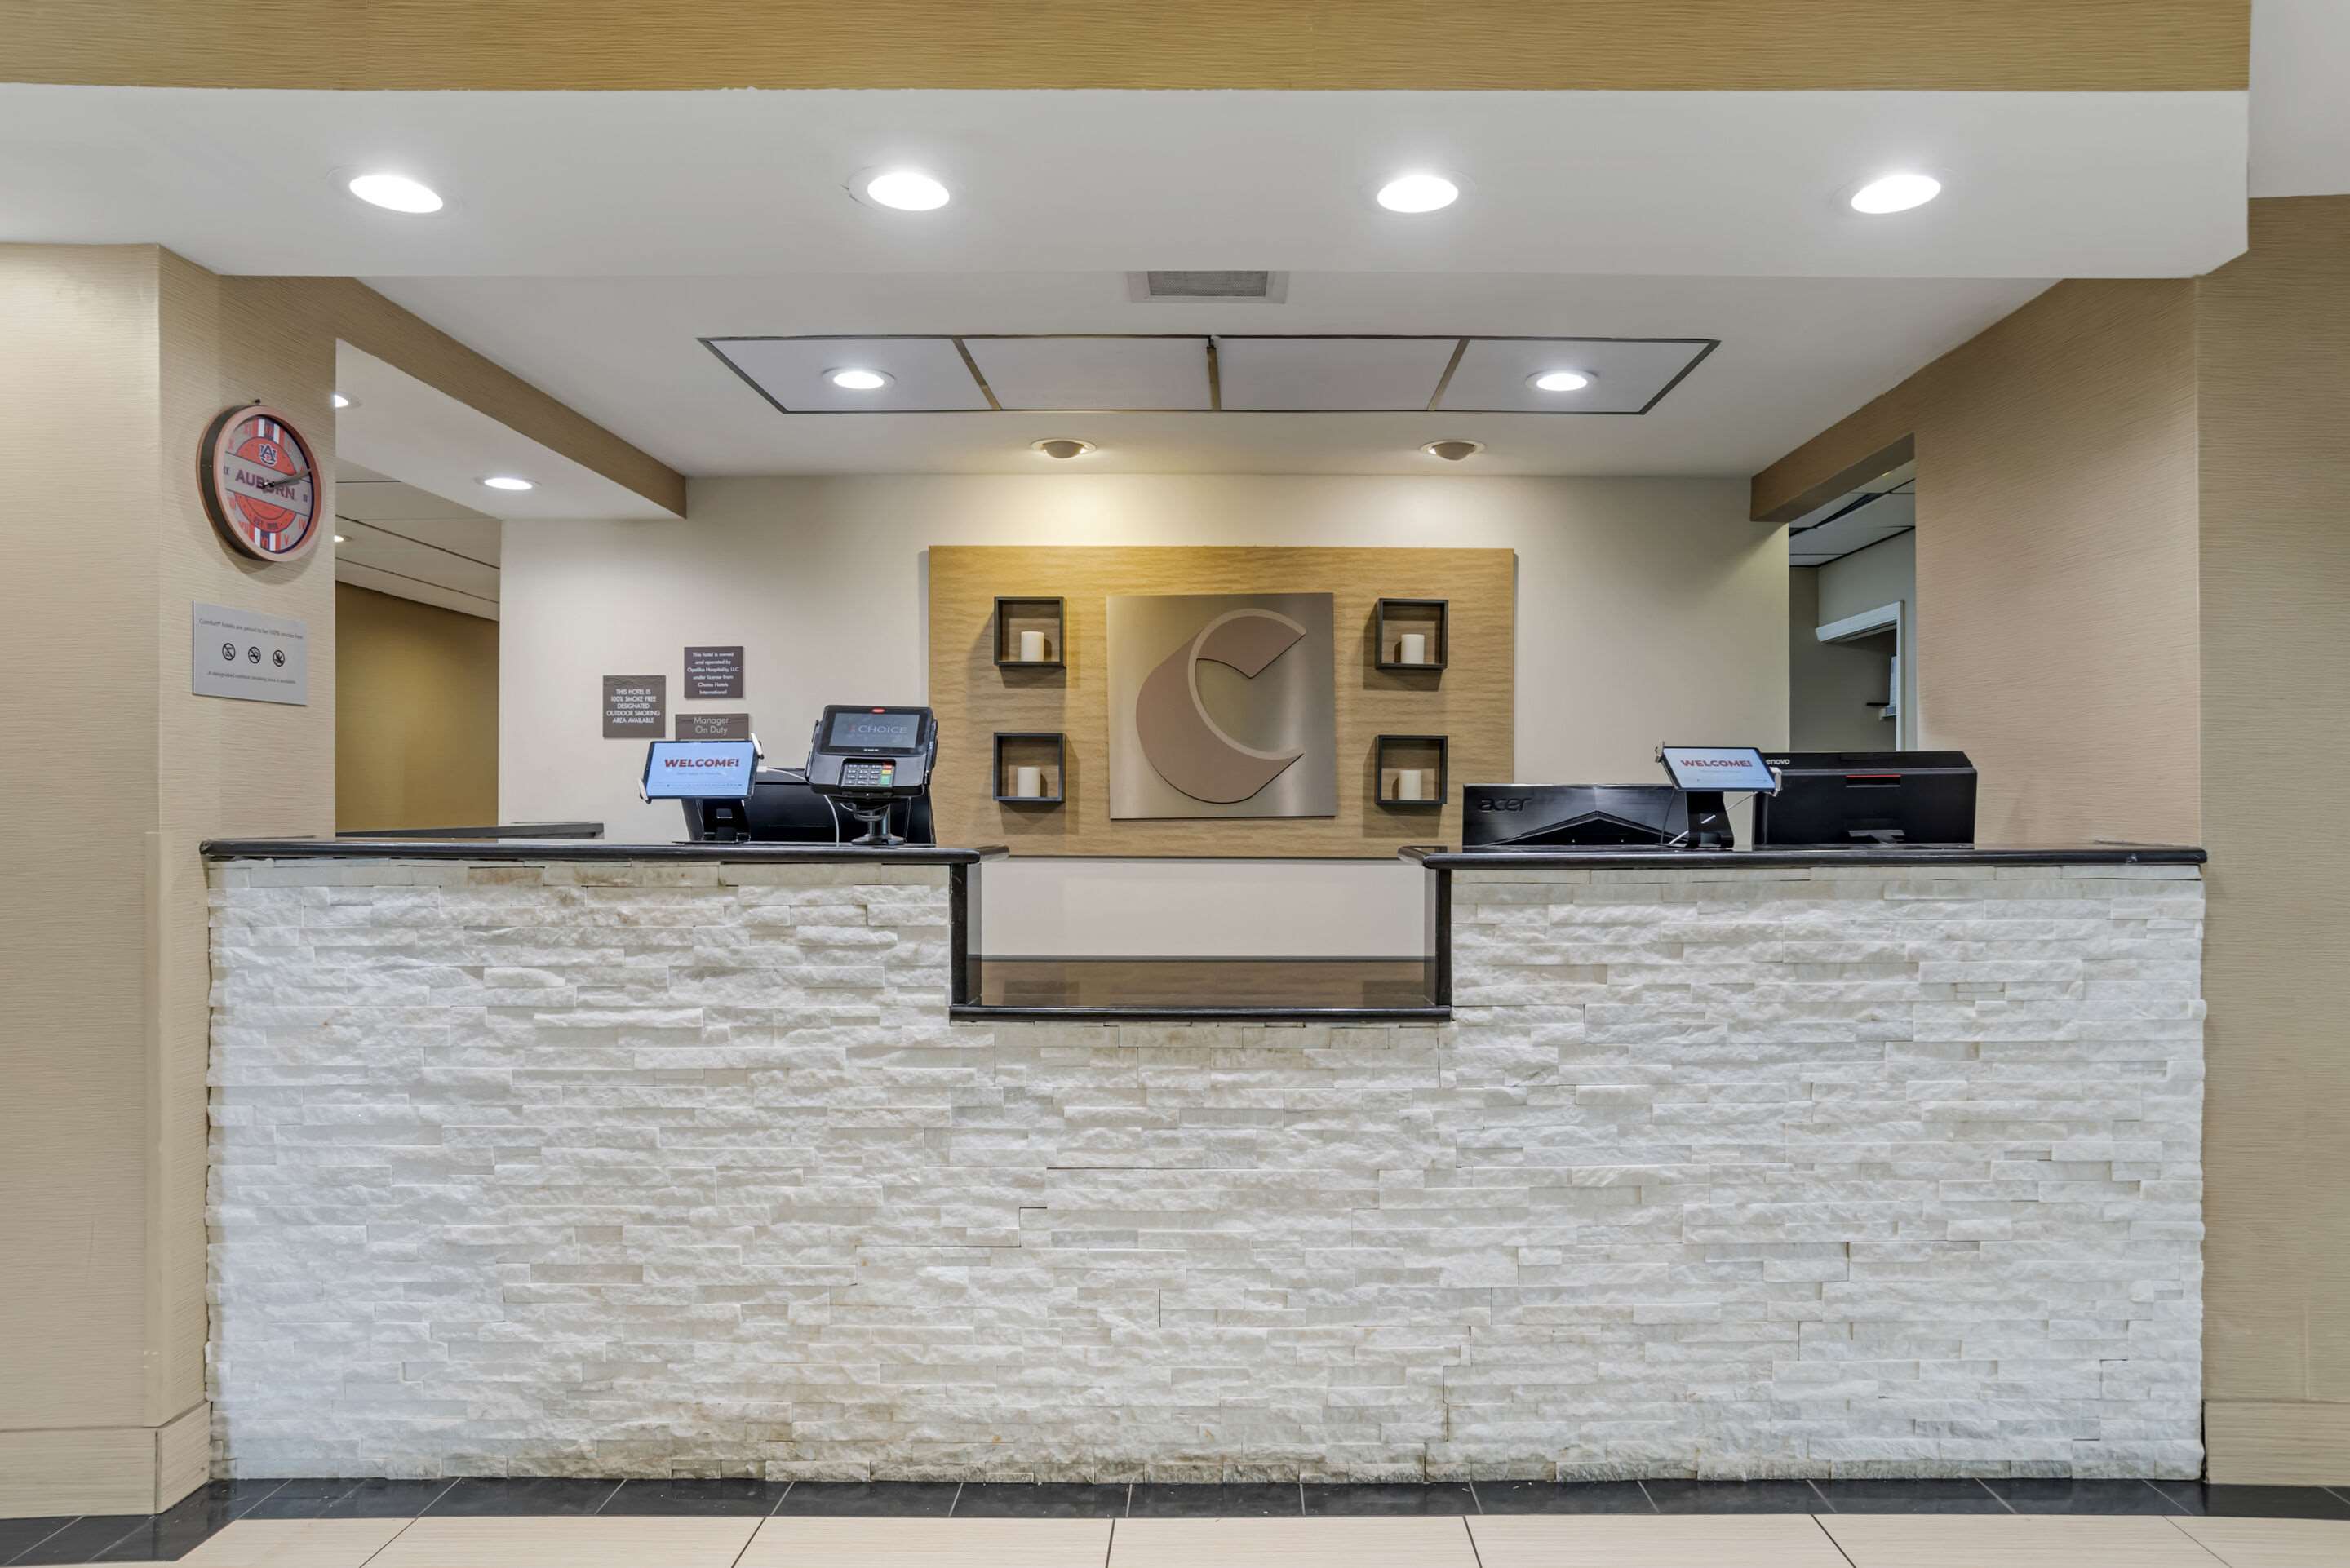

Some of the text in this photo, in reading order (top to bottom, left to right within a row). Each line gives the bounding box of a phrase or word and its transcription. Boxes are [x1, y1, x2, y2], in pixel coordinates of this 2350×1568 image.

[693, 717, 729, 726] Manager
[694, 725, 728, 734] On Duty
[858, 724, 908, 734] CHOICE
[664, 759, 739, 768] WELCOME!
[1680, 760, 1753, 768] WELCOME!
[1479, 797, 1532, 812] acer
